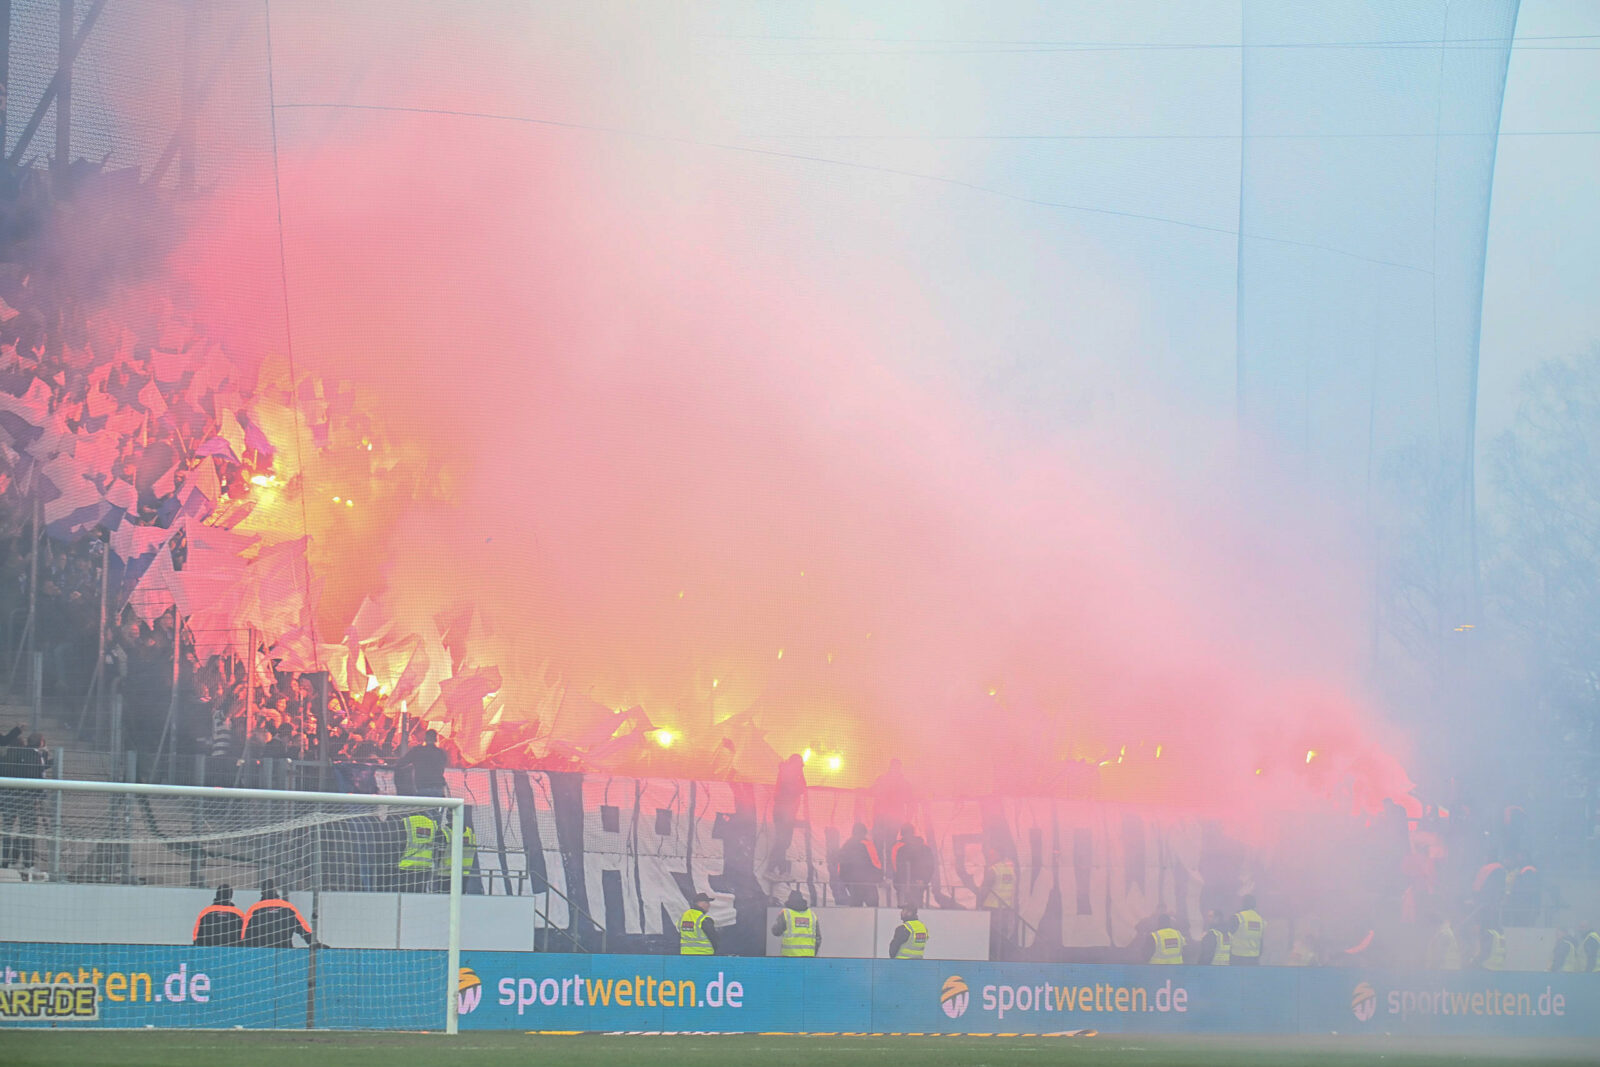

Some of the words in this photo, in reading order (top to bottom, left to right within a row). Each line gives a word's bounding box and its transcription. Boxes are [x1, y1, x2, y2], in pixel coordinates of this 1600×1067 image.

[581, 773, 737, 935] ARE
[498, 972, 744, 1015] sportwetten.de
[982, 979, 1188, 1019] sportwetten.de
[1387, 986, 1566, 1021] sportwetten.de
